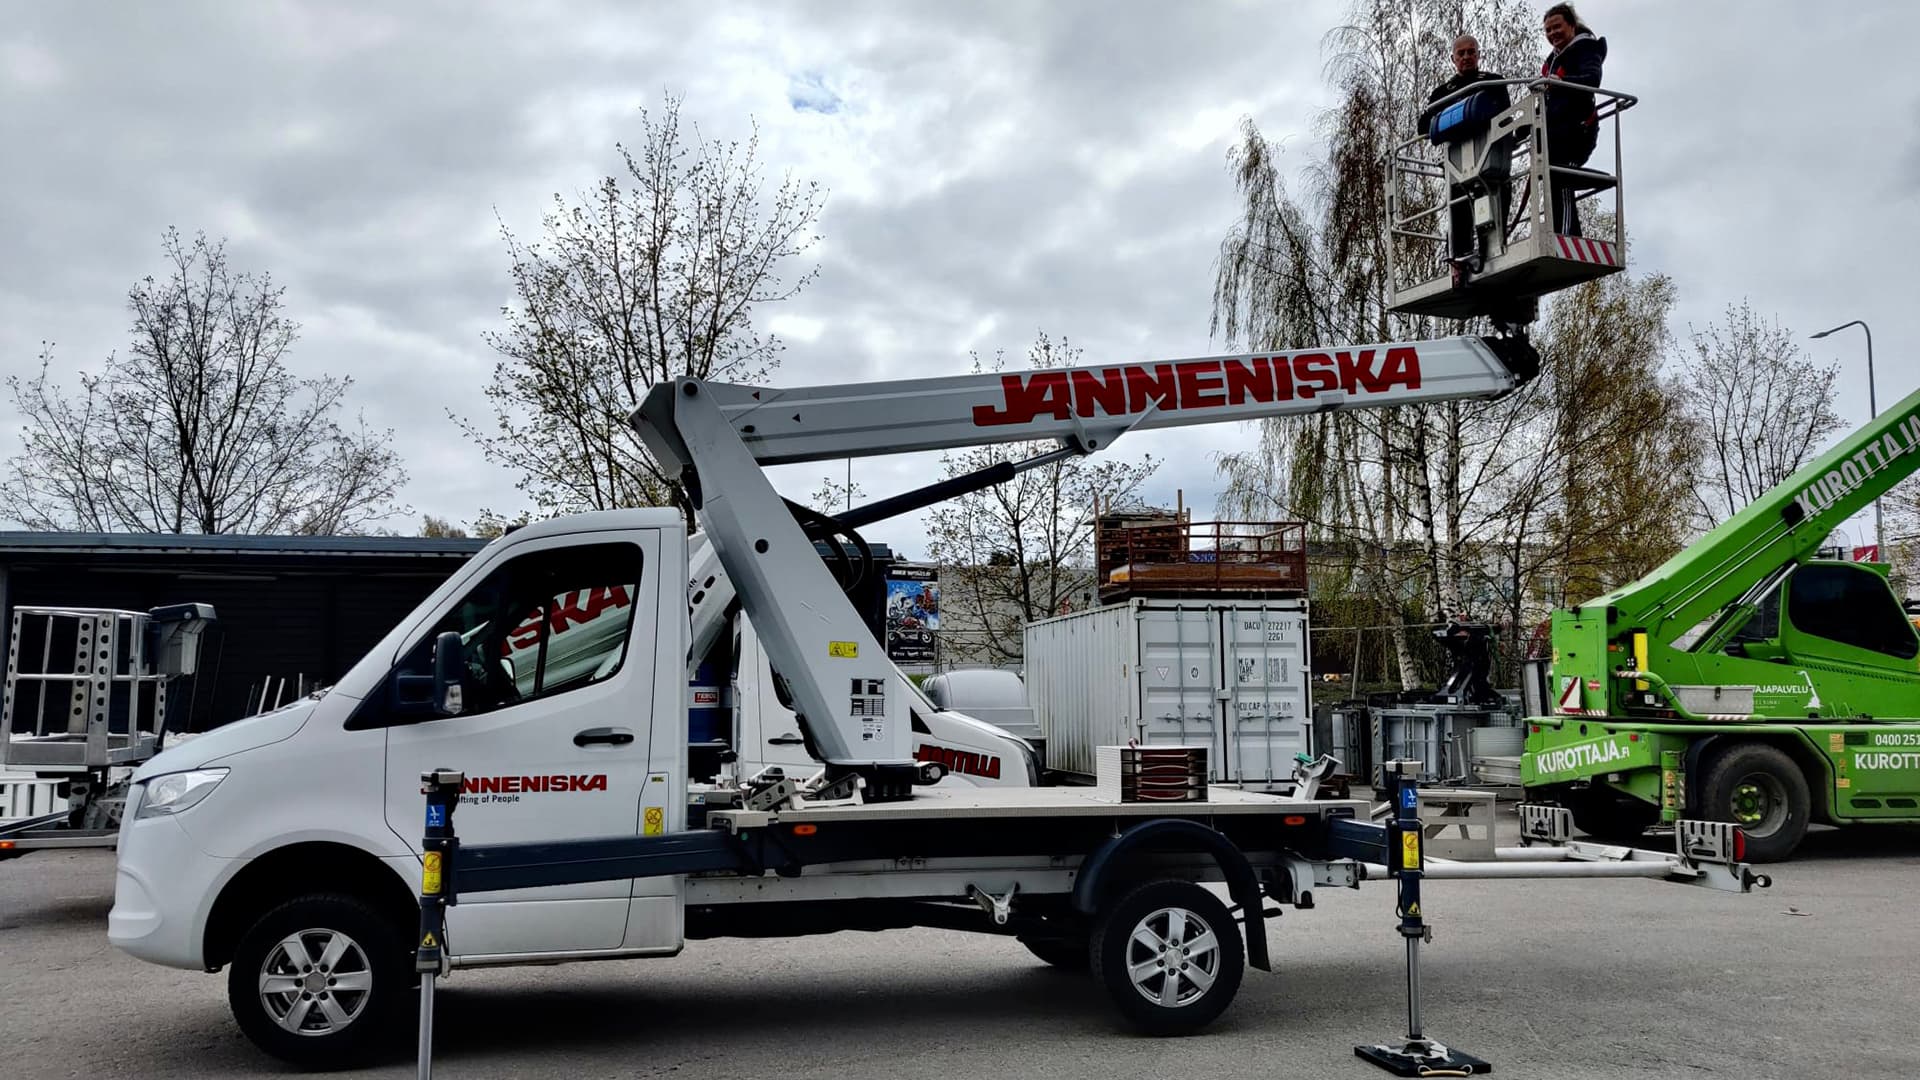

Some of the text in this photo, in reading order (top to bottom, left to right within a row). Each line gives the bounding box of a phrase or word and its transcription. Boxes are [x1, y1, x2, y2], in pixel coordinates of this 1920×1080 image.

[973, 347, 1421, 427] JANNENISKA
[1753, 685, 1808, 694] AJAPALVELU
[1875, 734, 1901, 746] 0400
[421, 774, 607, 795] NNENISKA
[481, 795, 490, 804] of
[491, 793, 520, 805] People
